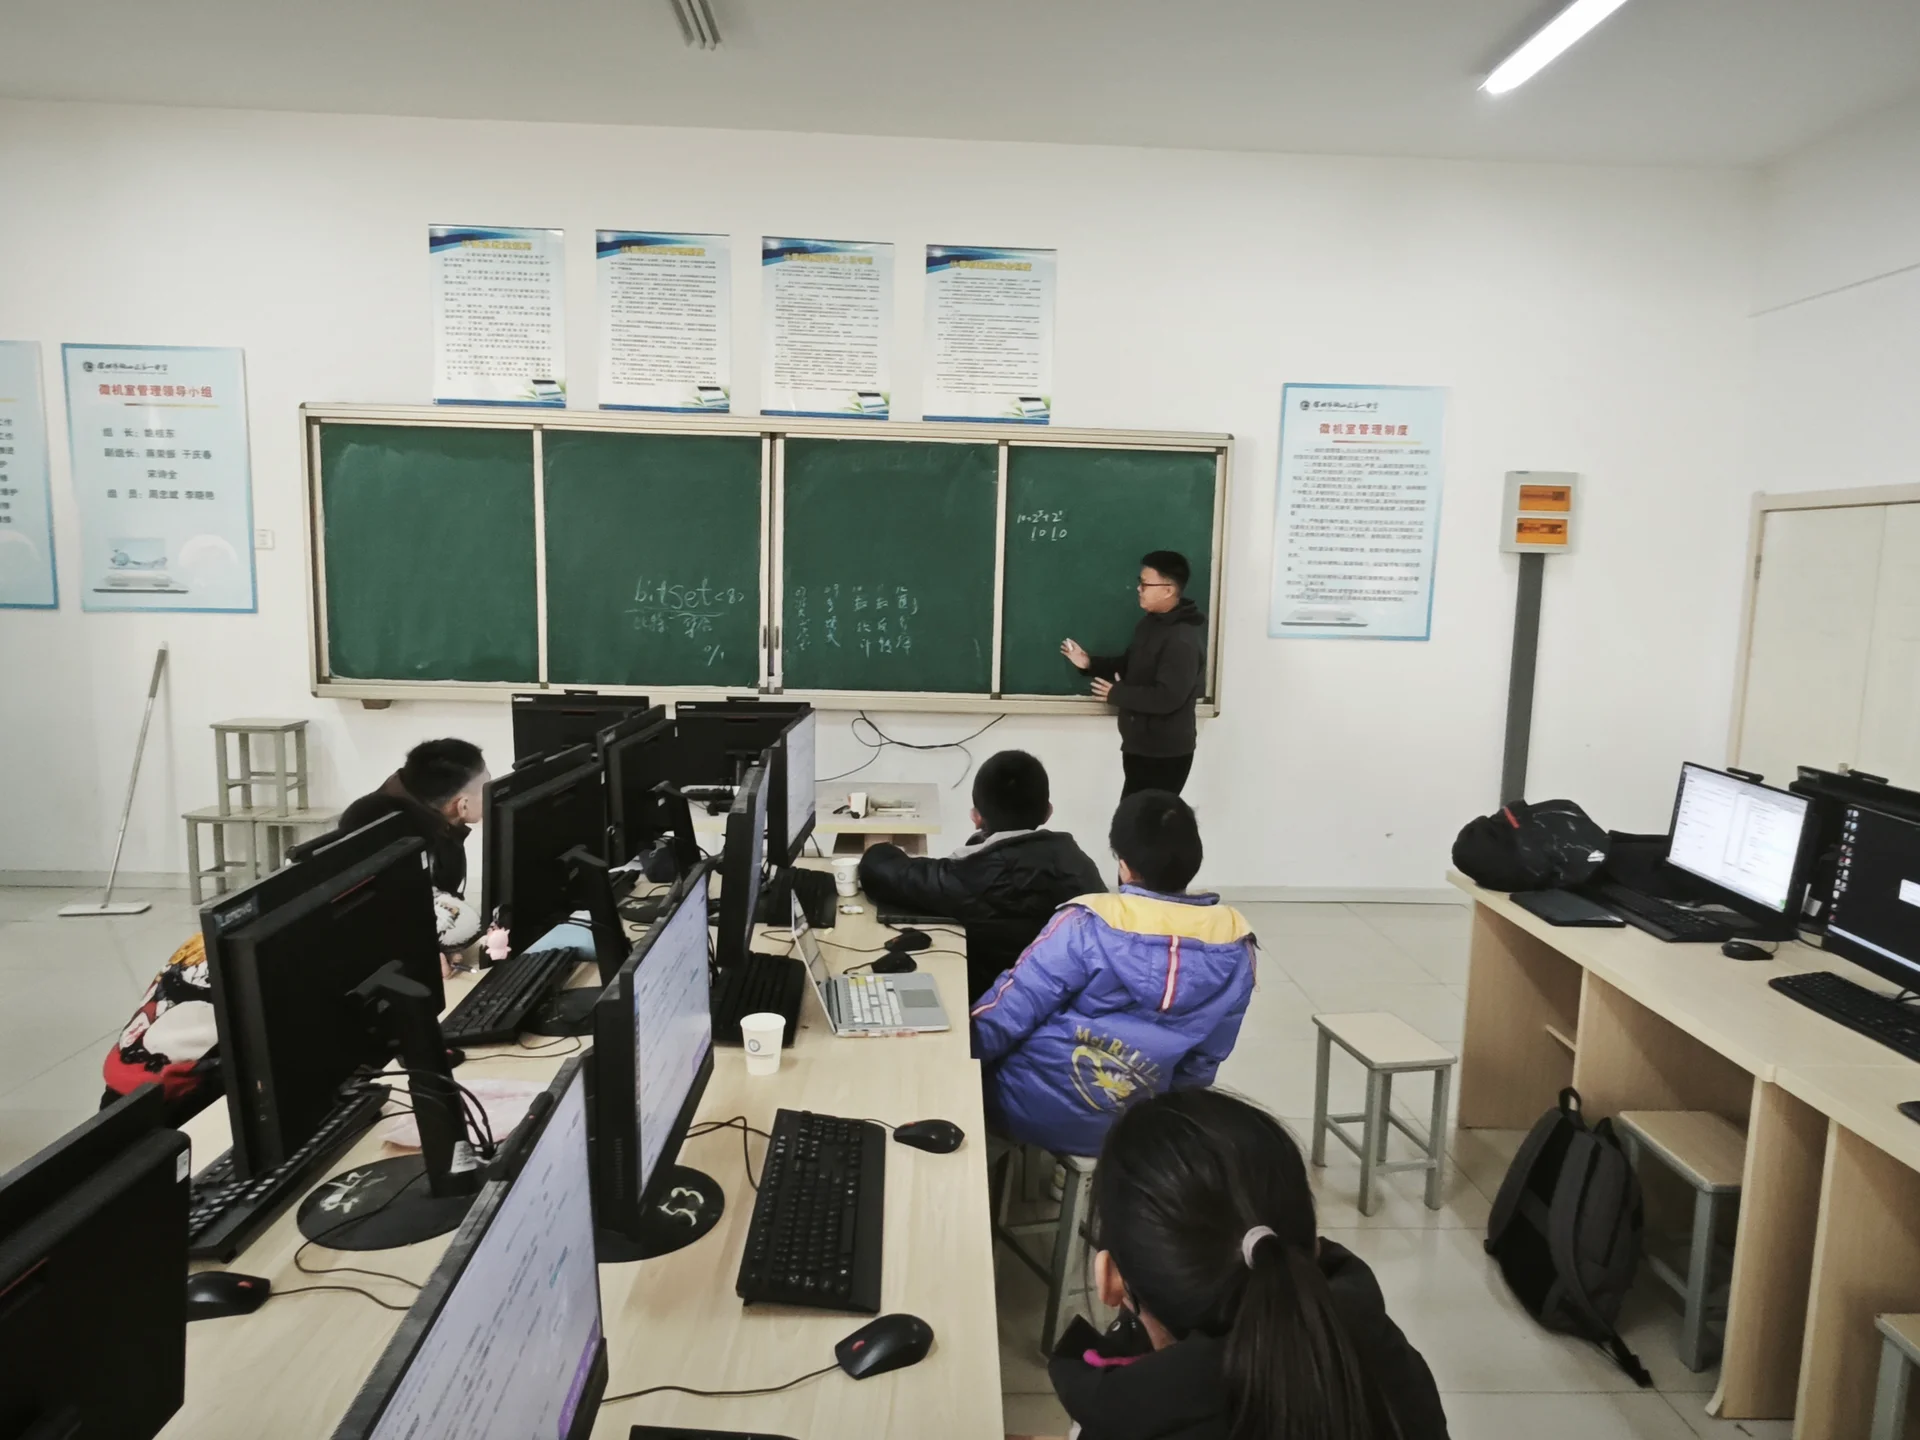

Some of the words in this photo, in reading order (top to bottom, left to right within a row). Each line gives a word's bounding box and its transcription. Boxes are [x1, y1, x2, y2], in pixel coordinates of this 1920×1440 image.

[99, 384, 213, 398] 微机室管理领导小组
[1320, 423, 1408, 436] 微机室管理制度
